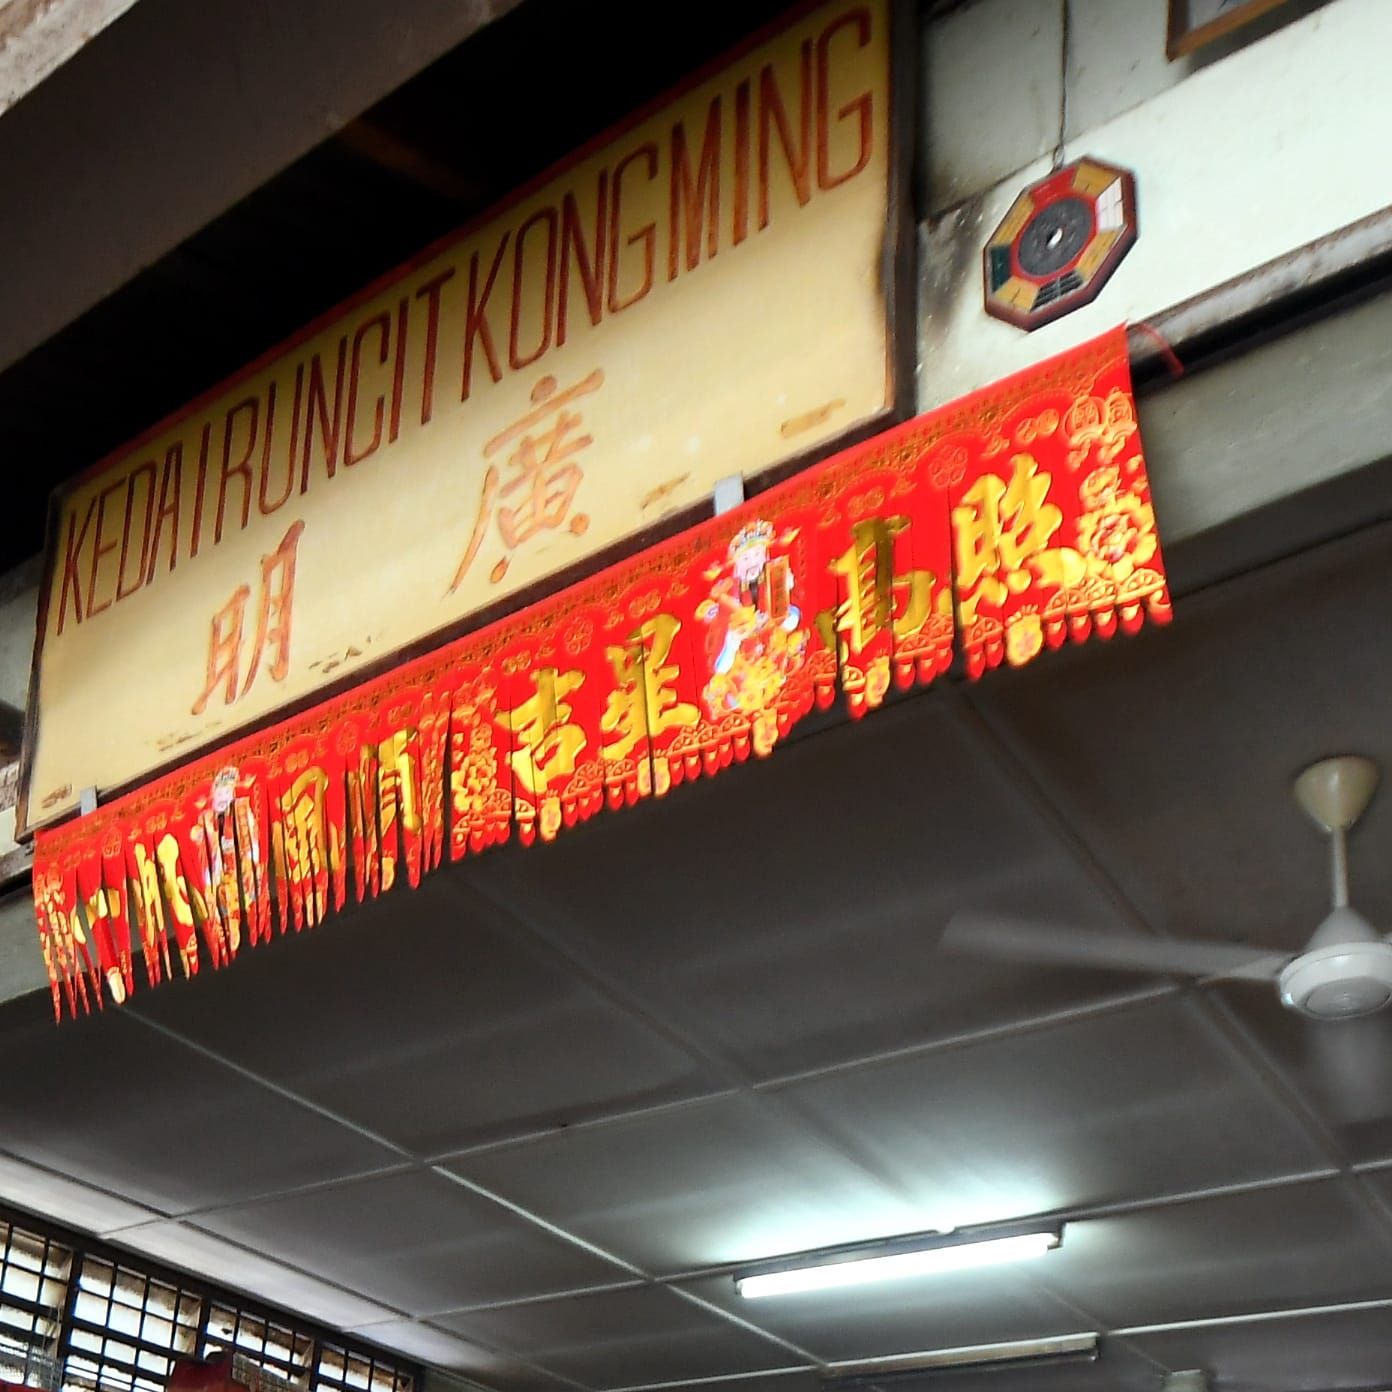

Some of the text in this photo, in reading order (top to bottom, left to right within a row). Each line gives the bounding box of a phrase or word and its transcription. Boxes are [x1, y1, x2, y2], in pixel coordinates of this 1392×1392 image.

[56, 7, 873, 637] KEDAI RUNCIT KONG MING
